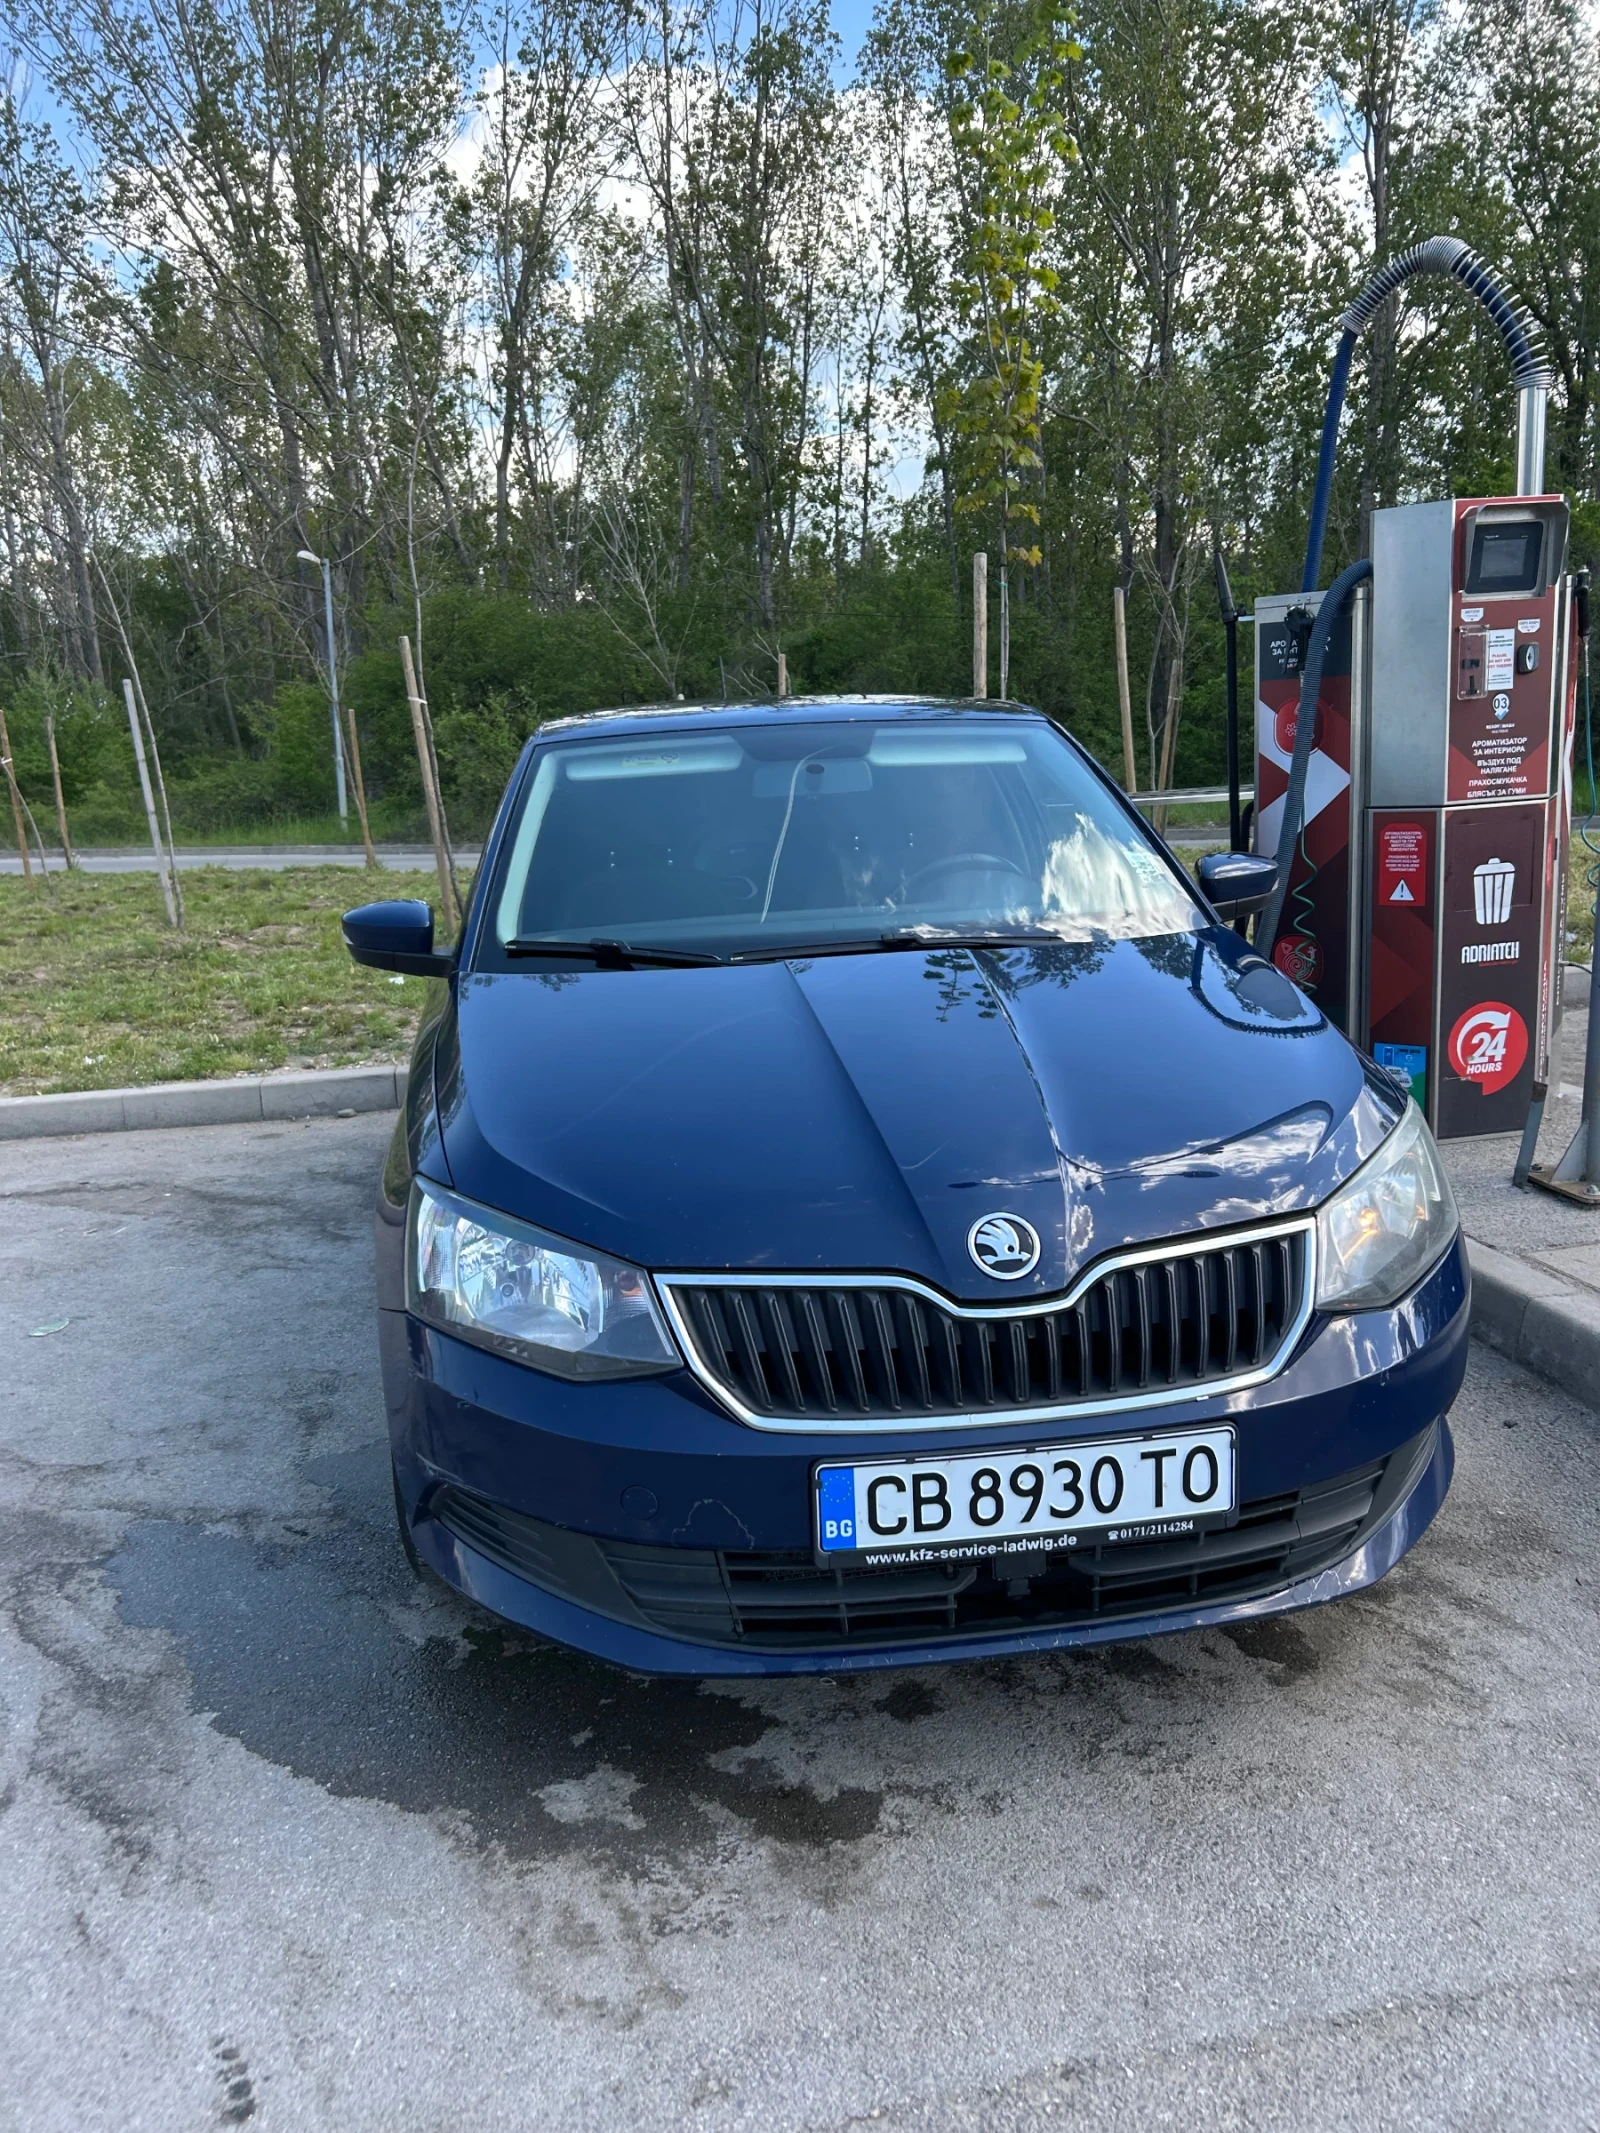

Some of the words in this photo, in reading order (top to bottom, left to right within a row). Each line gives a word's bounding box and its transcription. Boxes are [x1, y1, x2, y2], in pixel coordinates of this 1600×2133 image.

[1494, 697, 1507, 709] 03
[1472, 737, 1527, 748] АРОМАТИЗАТОР
[1484, 746, 1525, 755] ИНТЕРИОРА
[1477, 758, 1505, 767] ВЪЗДУХ
[1480, 765, 1517, 774] НАЛЯГАНЕ
[1469, 776, 1528, 787] ПРАХОСМУКАЧКА
[1467, 790, 1496, 798] БЛЯСЪК
[1507, 787, 1527, 795] ГУМИ
[1468, 1030, 1507, 1064] 24
[1466, 1062, 1503, 1075] HOURS
[867, 1472, 952, 1536] CB
[969, 1455, 1124, 1527] 8930
[1140, 1445, 1219, 1508] TO
[825, 1519, 853, 1539] BG
[1120, 1520, 1194, 1540] 0171/2114284
[866, 1534, 1077, 1564] www.kfz-service-ladwig.de
